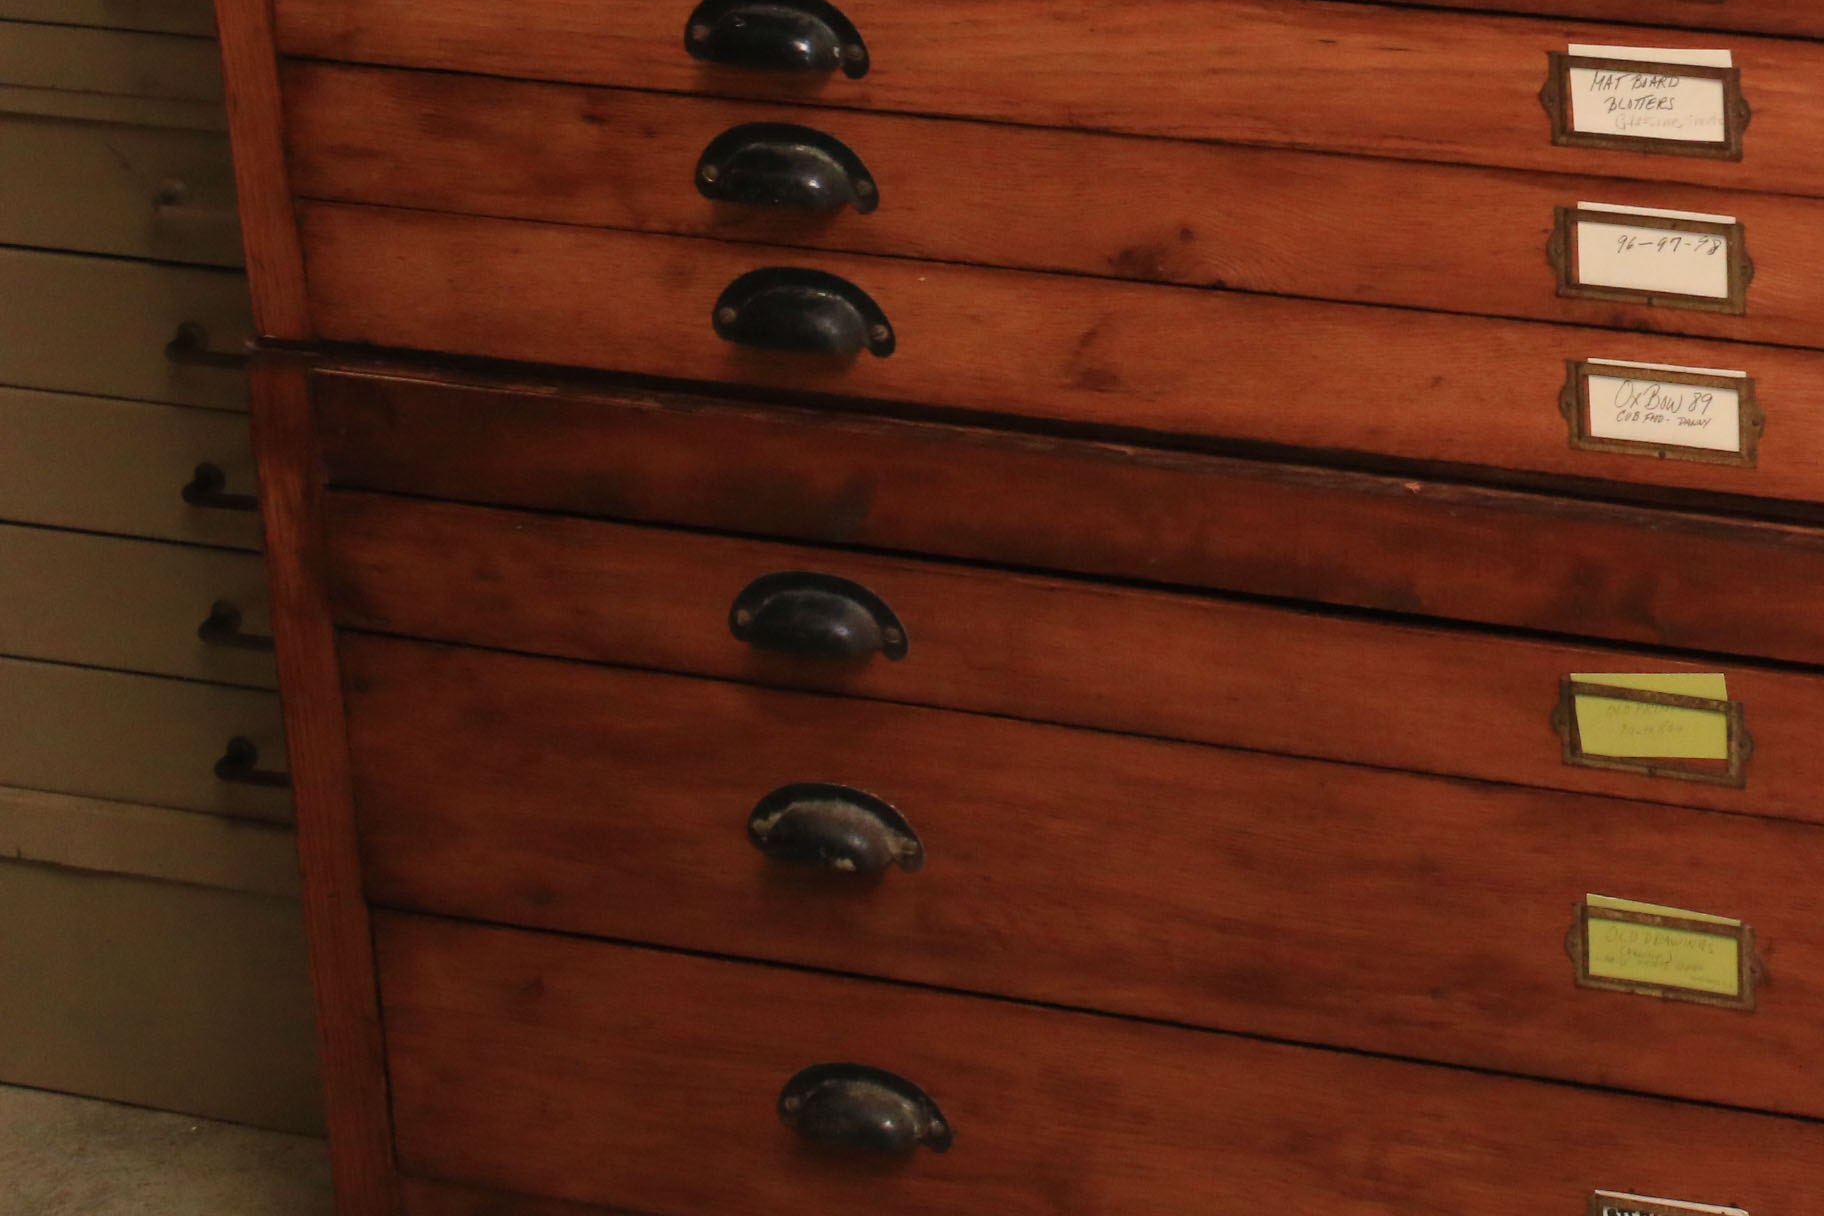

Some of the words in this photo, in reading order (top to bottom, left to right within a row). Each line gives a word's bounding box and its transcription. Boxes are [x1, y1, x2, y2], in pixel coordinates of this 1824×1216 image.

[1590, 71, 1631, 91] MAT
[1631, 74, 1681, 91] BOARD
[1603, 94, 1676, 114] BLOTTERS
[1687, 391, 1713, 415] 89
